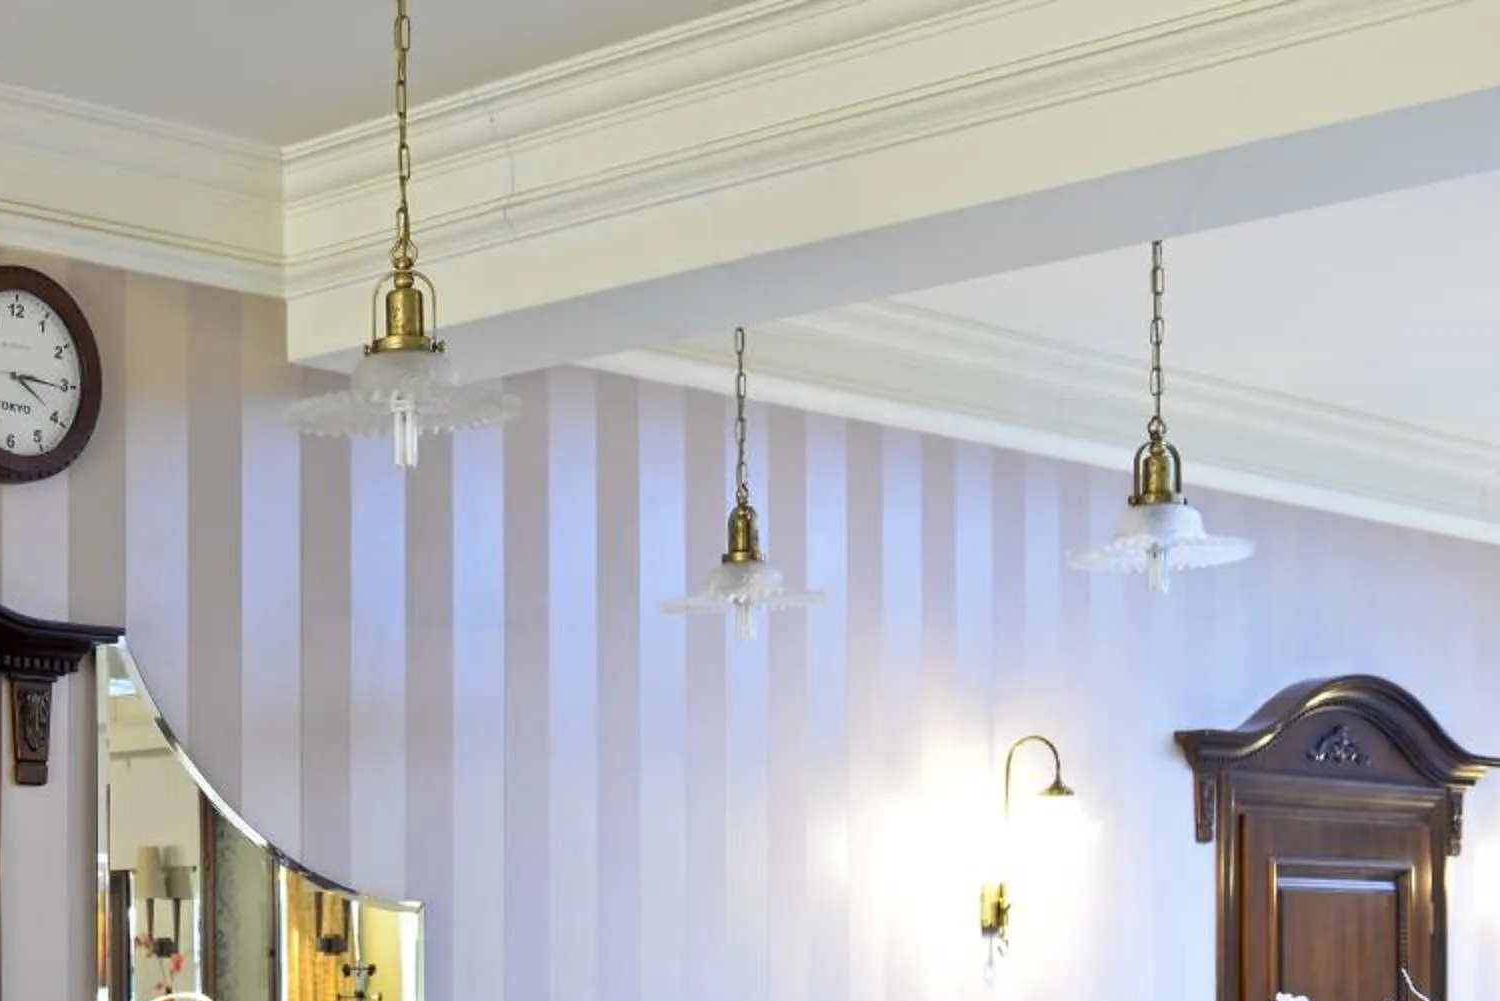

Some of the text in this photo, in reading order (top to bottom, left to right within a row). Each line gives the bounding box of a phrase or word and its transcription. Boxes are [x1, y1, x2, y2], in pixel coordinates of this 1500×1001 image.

[8, 303, 25, 318] 12
[39, 320, 46, 333] 1
[54, 346, 63, 359] 2
[60, 378, 68, 392] 3
[50, 411, 59, 424] 4
[6, 434, 15, 448] 6
[33, 429, 42, 443] 5
